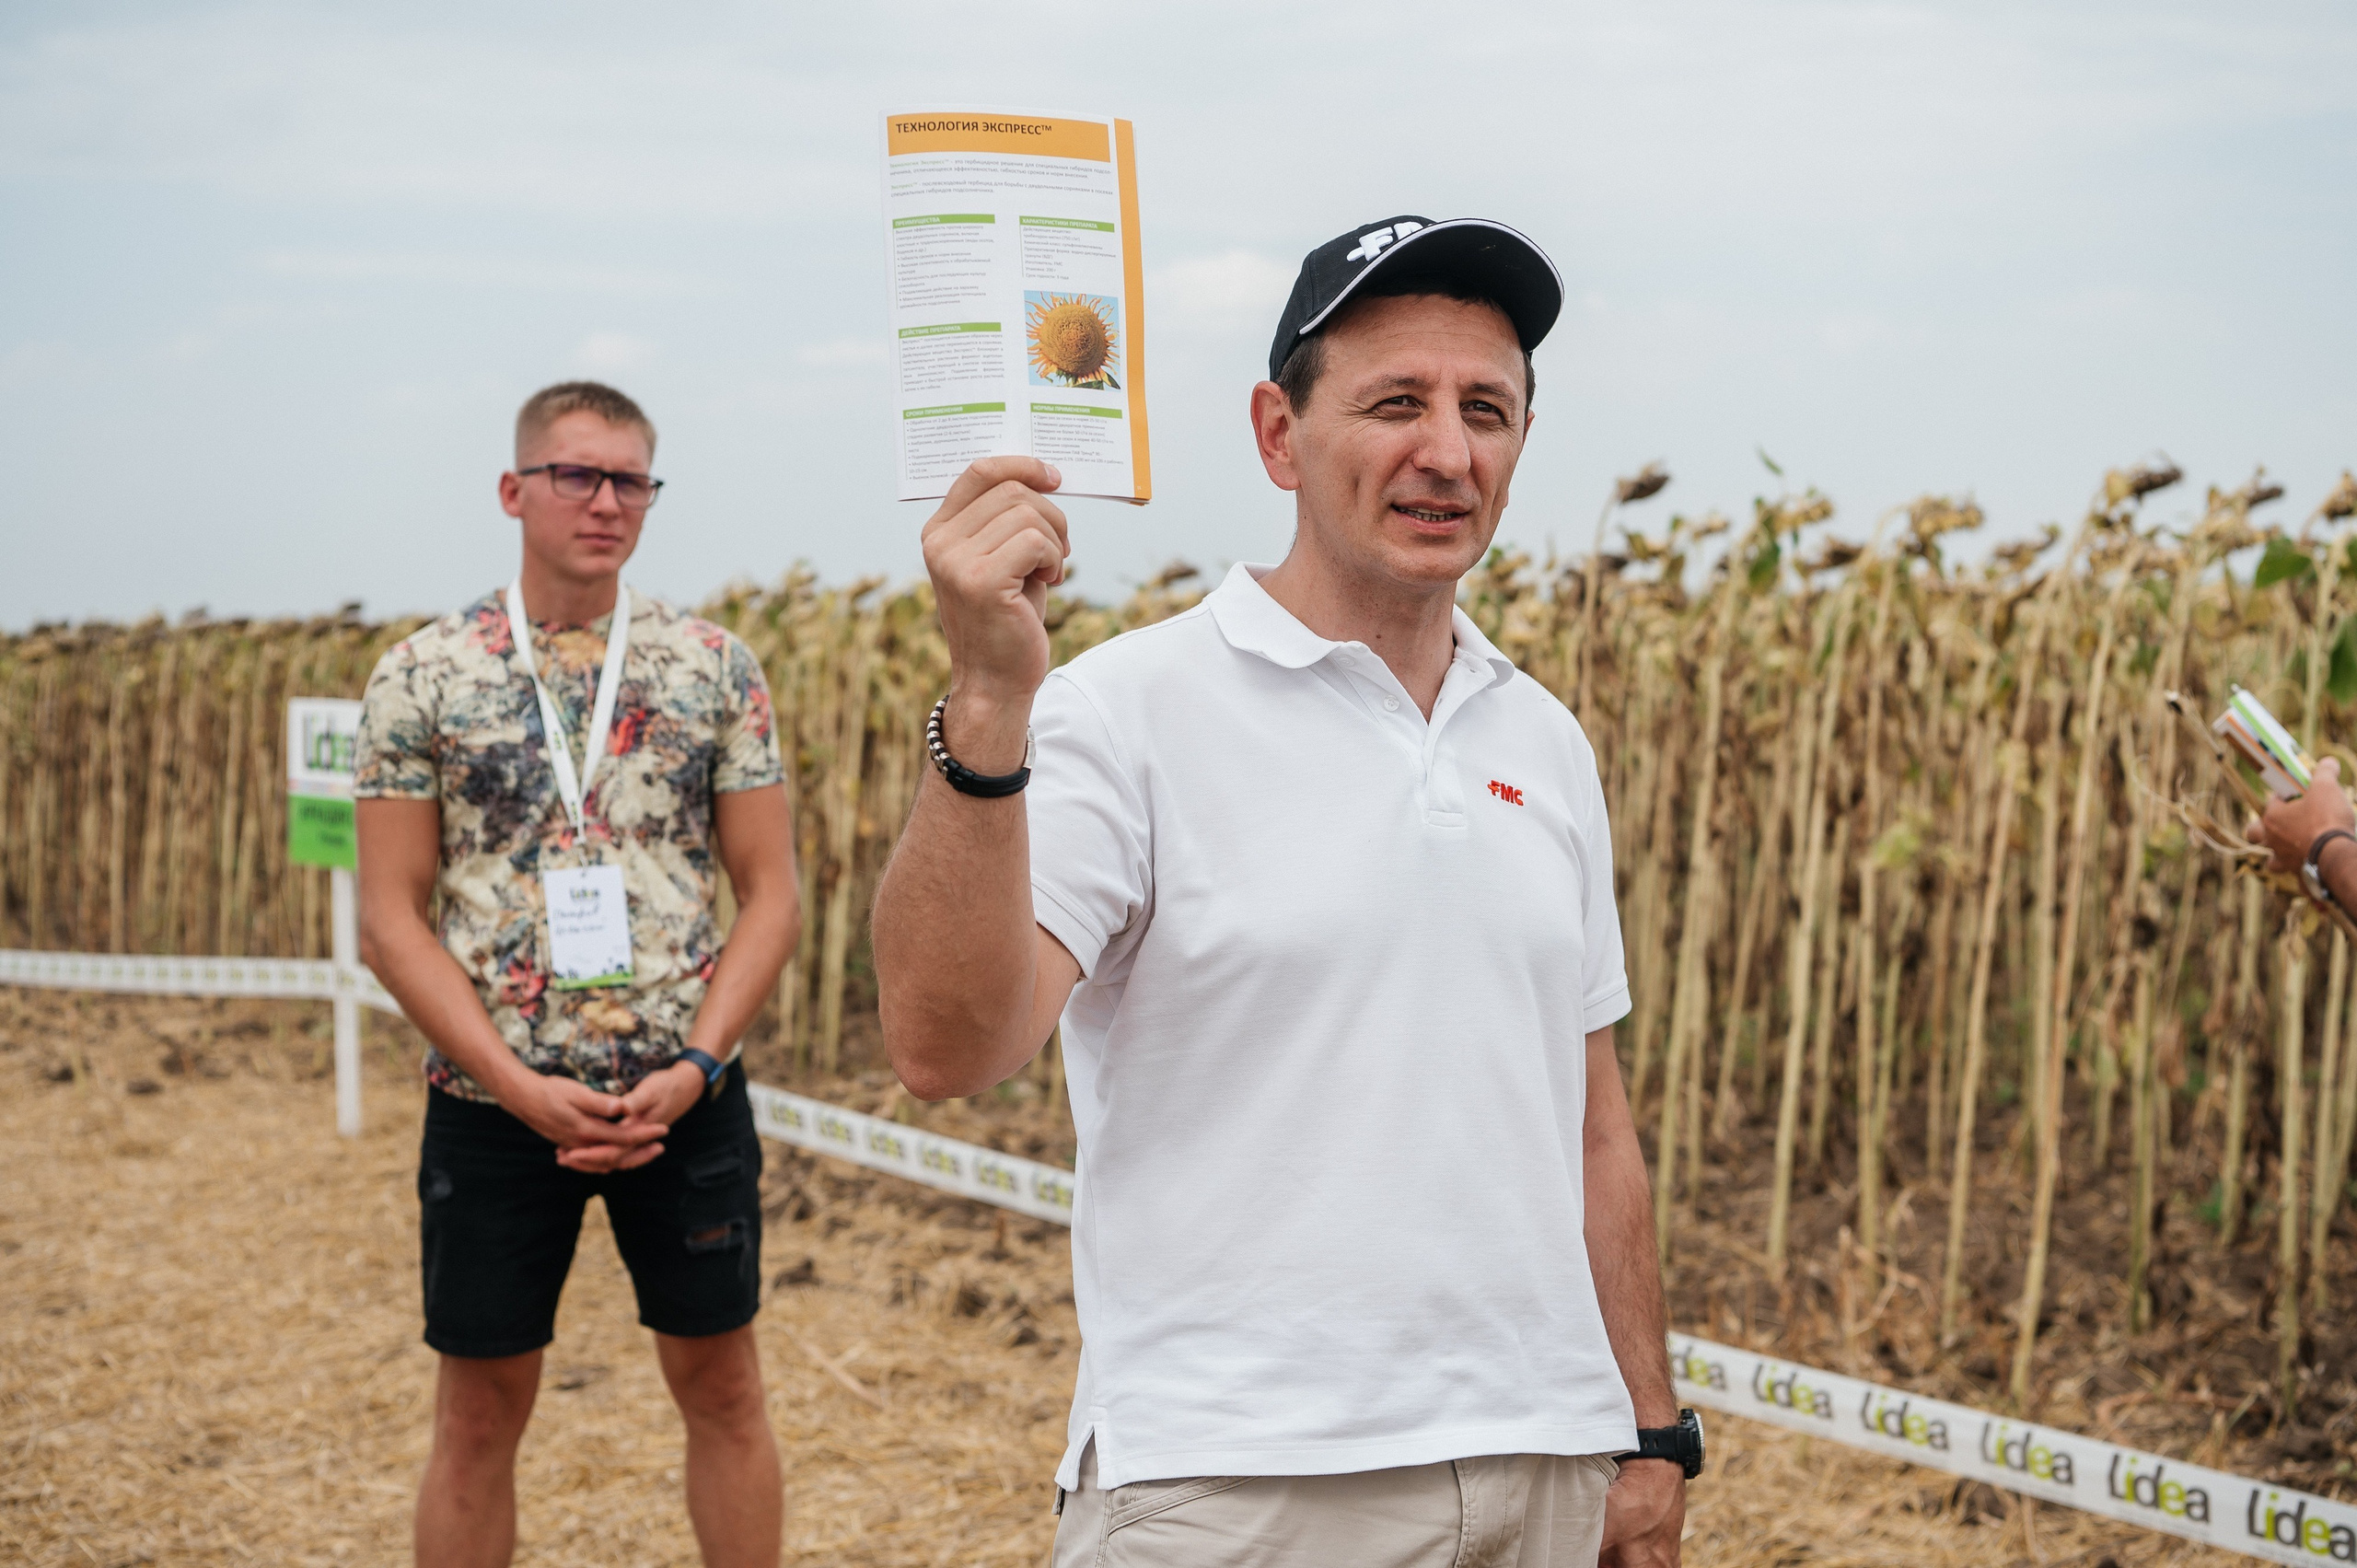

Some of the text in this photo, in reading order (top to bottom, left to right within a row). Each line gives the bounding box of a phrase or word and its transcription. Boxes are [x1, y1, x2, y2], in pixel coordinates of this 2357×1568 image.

[896, 122, 979, 133] ТЕХНОЛОГИЯ
[1487, 780, 1524, 806] FMC
[1667, 1345, 2357, 1562] dea Lidea Lidea Lidea Lidea Lidea
